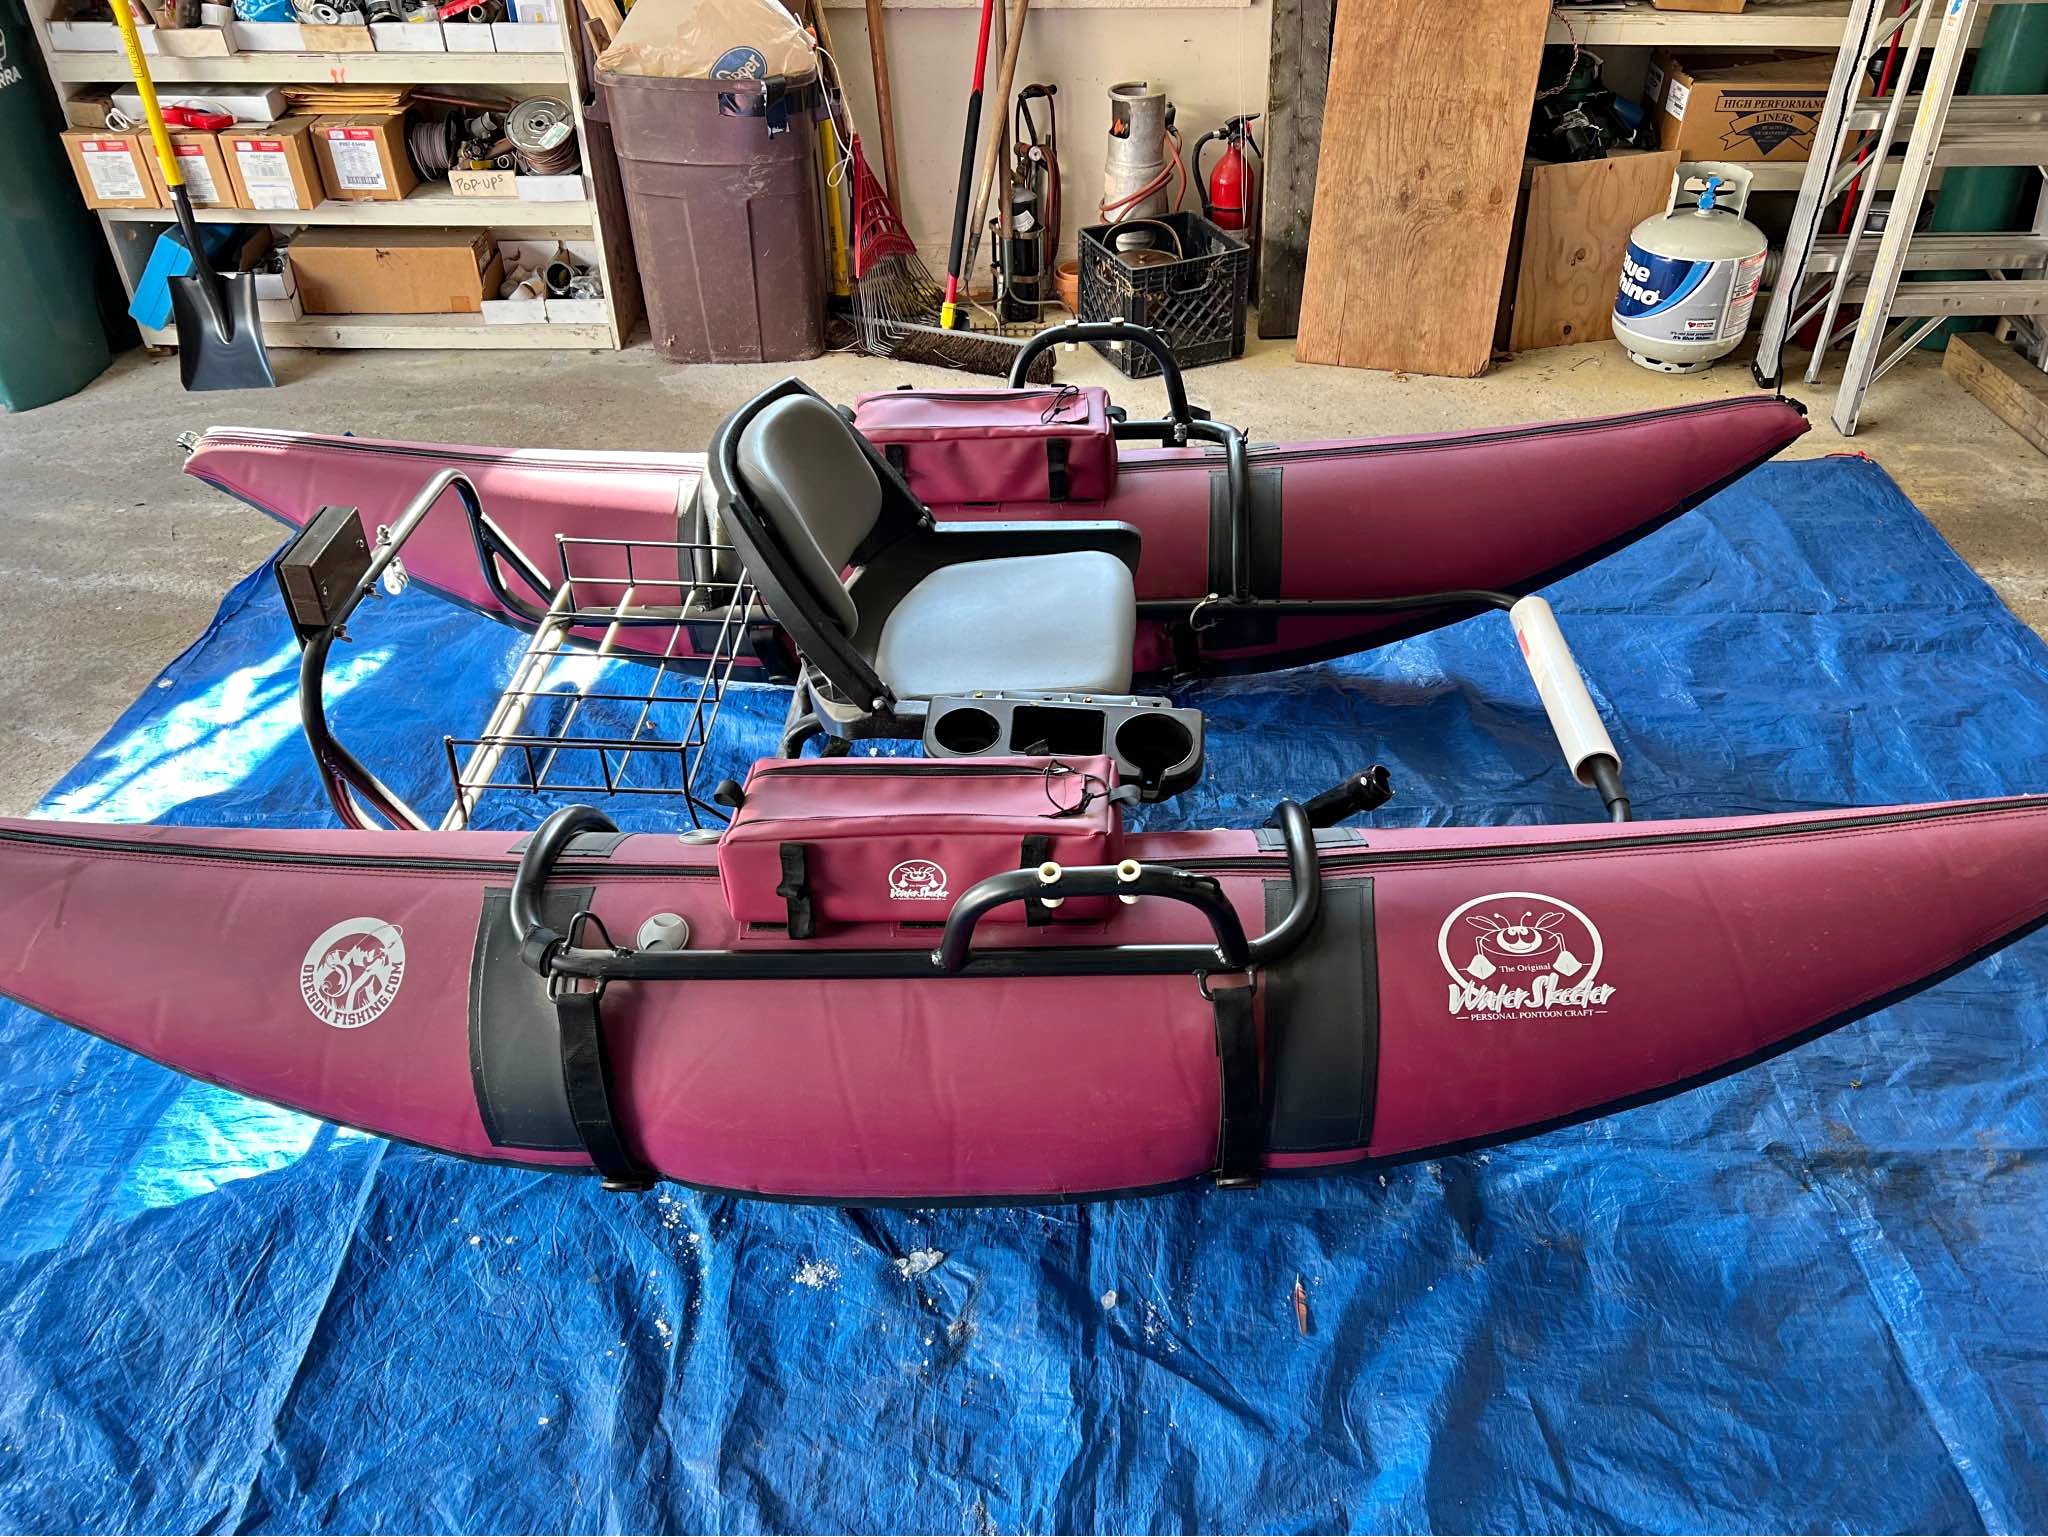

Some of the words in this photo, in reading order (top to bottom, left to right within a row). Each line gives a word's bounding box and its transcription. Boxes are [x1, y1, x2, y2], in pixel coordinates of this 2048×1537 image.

[716, 54, 761, 80] oger
[1723, 99, 1752, 109] HIGH
[1754, 99, 1826, 109] PERFORMANC
[1755, 112, 1795, 124] LINERS
[1624, 249, 1651, 283] lue
[1619, 267, 1659, 306] hino
[1499, 965, 1516, 973] The
[1517, 963, 1551, 973] Original
[302, 964, 332, 1020] OREGON
[1470, 1012, 1518, 1022] PERSONAL
[1519, 1010, 1563, 1019] PONTOON
[1564, 1009, 1594, 1017] CRAFT
